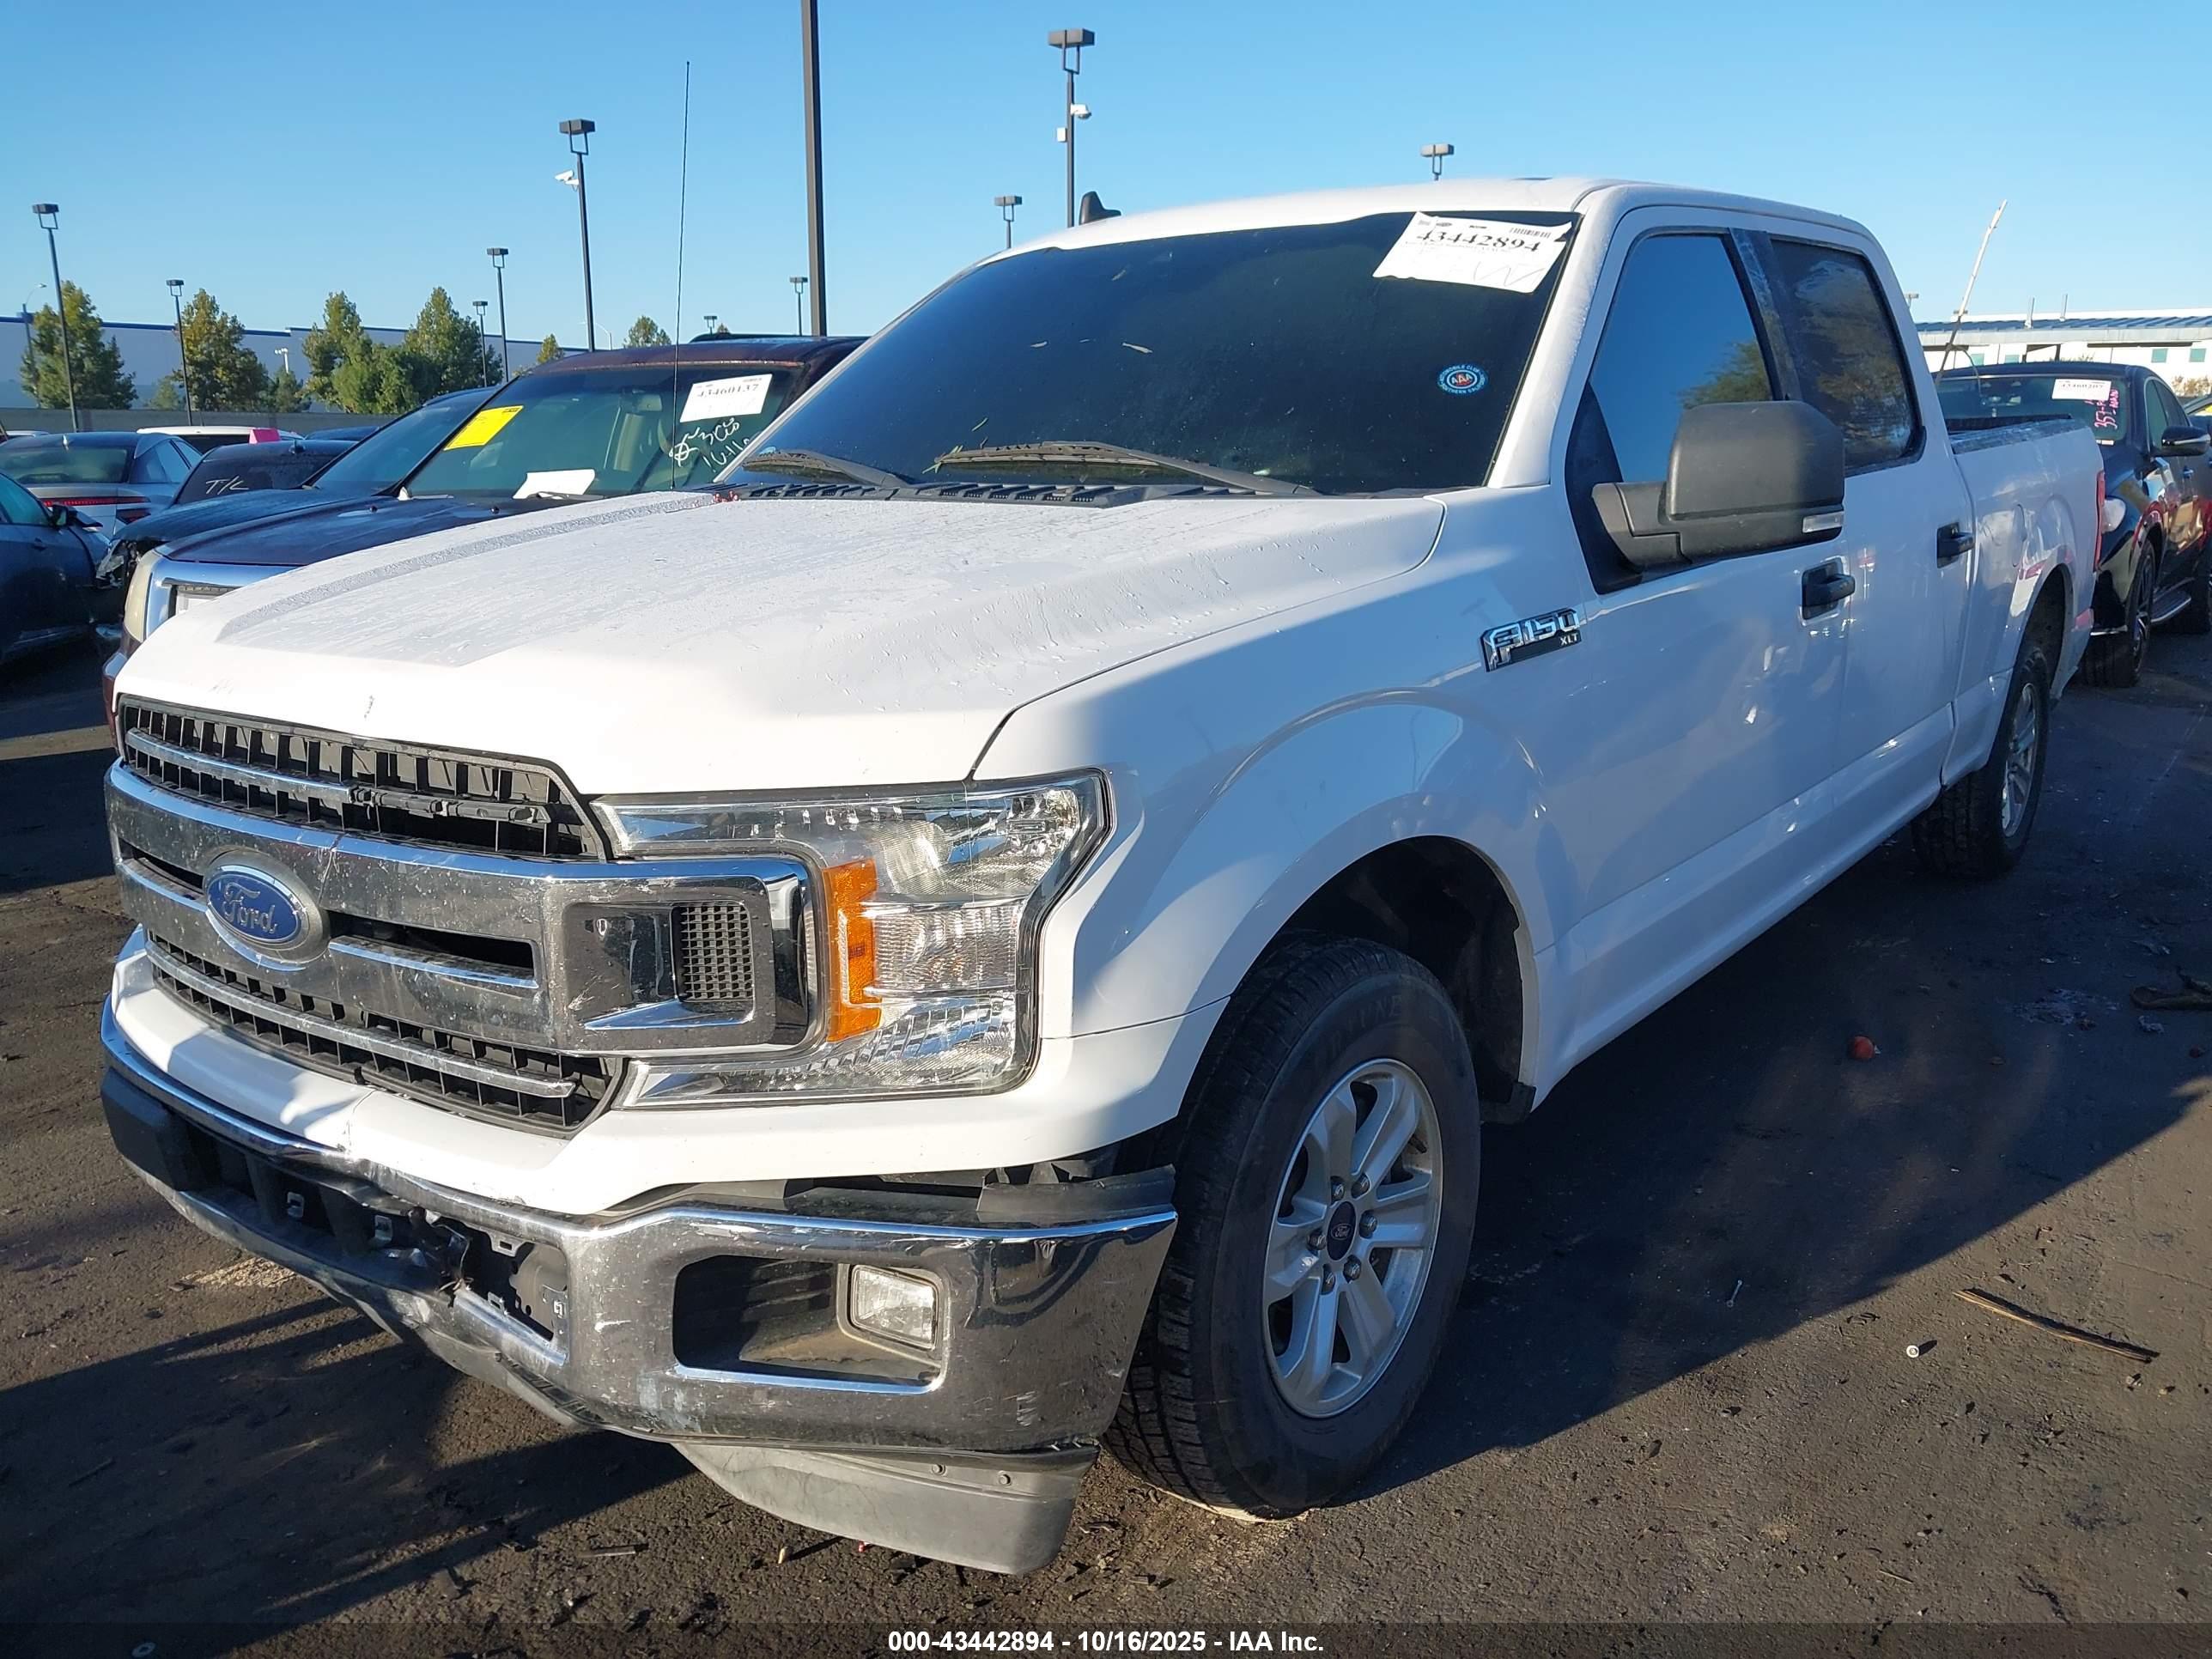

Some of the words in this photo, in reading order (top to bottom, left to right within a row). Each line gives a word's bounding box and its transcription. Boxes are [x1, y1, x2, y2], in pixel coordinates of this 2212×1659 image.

[1416, 230, 1540, 252] 43442894
[1560, 633, 1579, 647] XLT
[222, 881, 279, 934] Ford
